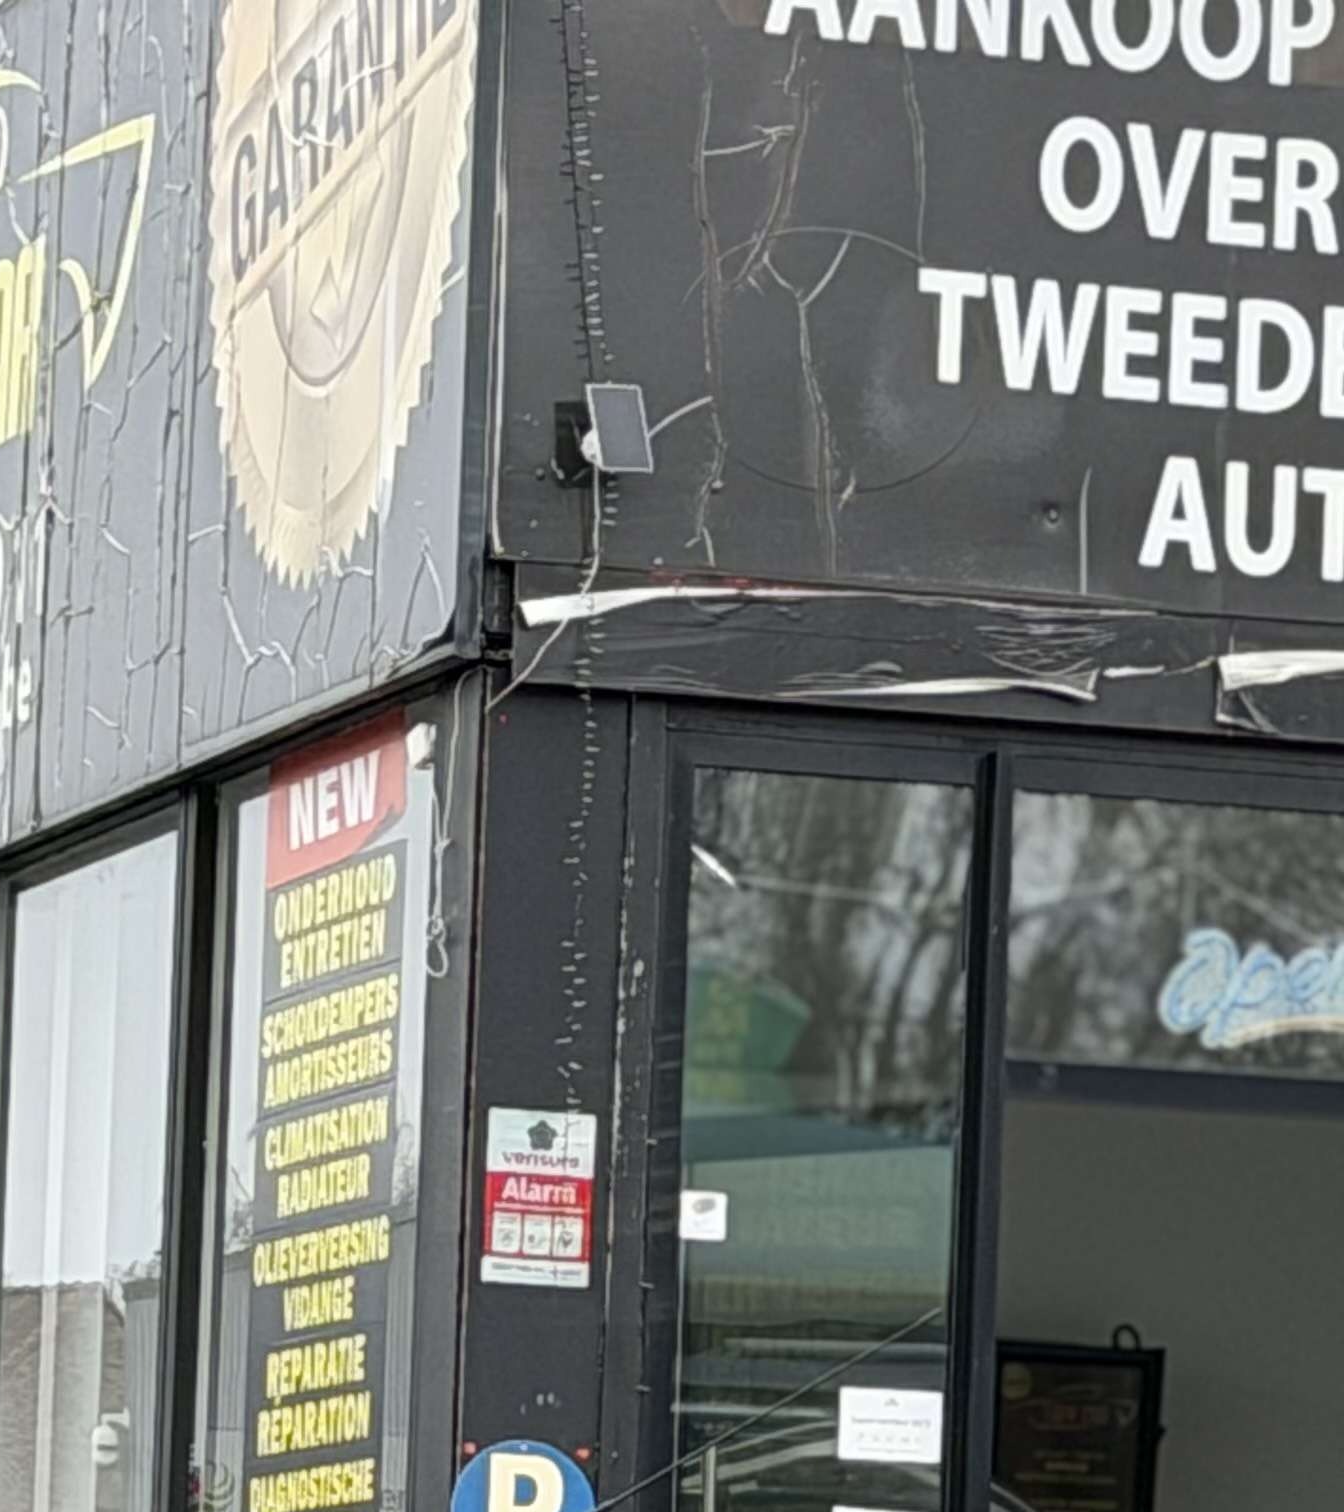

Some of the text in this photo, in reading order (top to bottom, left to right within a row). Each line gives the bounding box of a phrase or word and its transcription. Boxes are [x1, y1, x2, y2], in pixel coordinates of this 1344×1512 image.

[230, 0, 457, 283] GARANT
[289, 749, 381, 851] NEW
[274, 853, 397, 942] ONDERHOUD
[280, 908, 387, 988] ENTRETIEN
[261, 973, 399, 1059] SCHOKDEMPERS
[264, 1028, 393, 1109] AMORTISSEURS
[265, 1095, 389, 1171] CLIMATISATION
[277, 1153, 371, 1219] RADIATEUR
[502, 1176, 577, 1205] Alarm
[253, 1214, 391, 1288] OLIEVERVERSING
[283, 1274, 355, 1332] VIDANGE
[266, 1334, 367, 1399] REPARATIE
